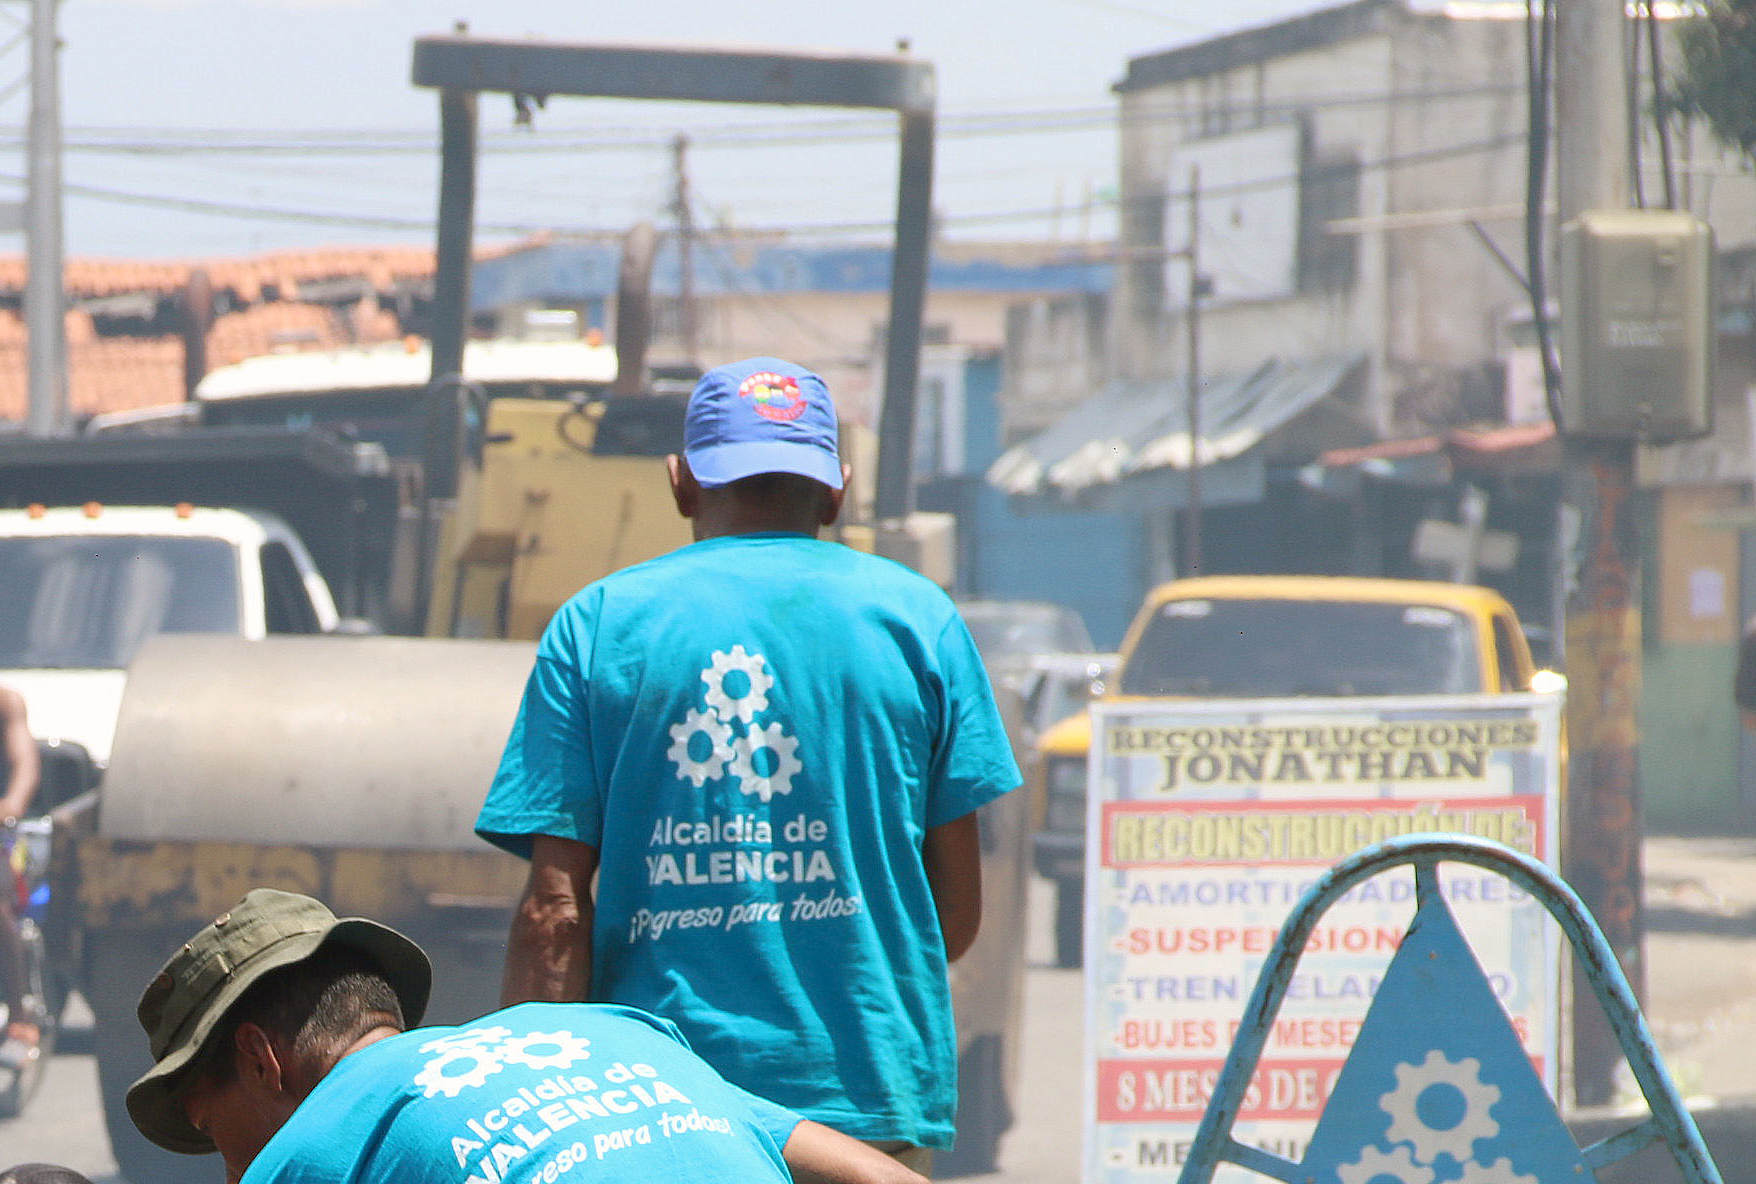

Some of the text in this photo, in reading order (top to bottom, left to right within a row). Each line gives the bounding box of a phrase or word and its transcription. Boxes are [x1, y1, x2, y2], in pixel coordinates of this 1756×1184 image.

[1112, 722, 1539, 751] RECONSTRUCCIONES
[1158, 750, 1488, 791] JONATHAN
[650, 813, 828, 847] Alcaldía de
[645, 850, 836, 885] VALENCIA
[725, 903, 784, 932] para
[1113, 928, 1404, 954] -SUSPESION
[1117, 1071, 1137, 1112] 8
[1143, 1070, 1262, 1112] MESS
[1268, 1068, 1320, 1111] DE
[451, 1062, 659, 1170] Alcaldía de
[594, 1124, 651, 1160] para
[657, 1107, 735, 1137] todos!
